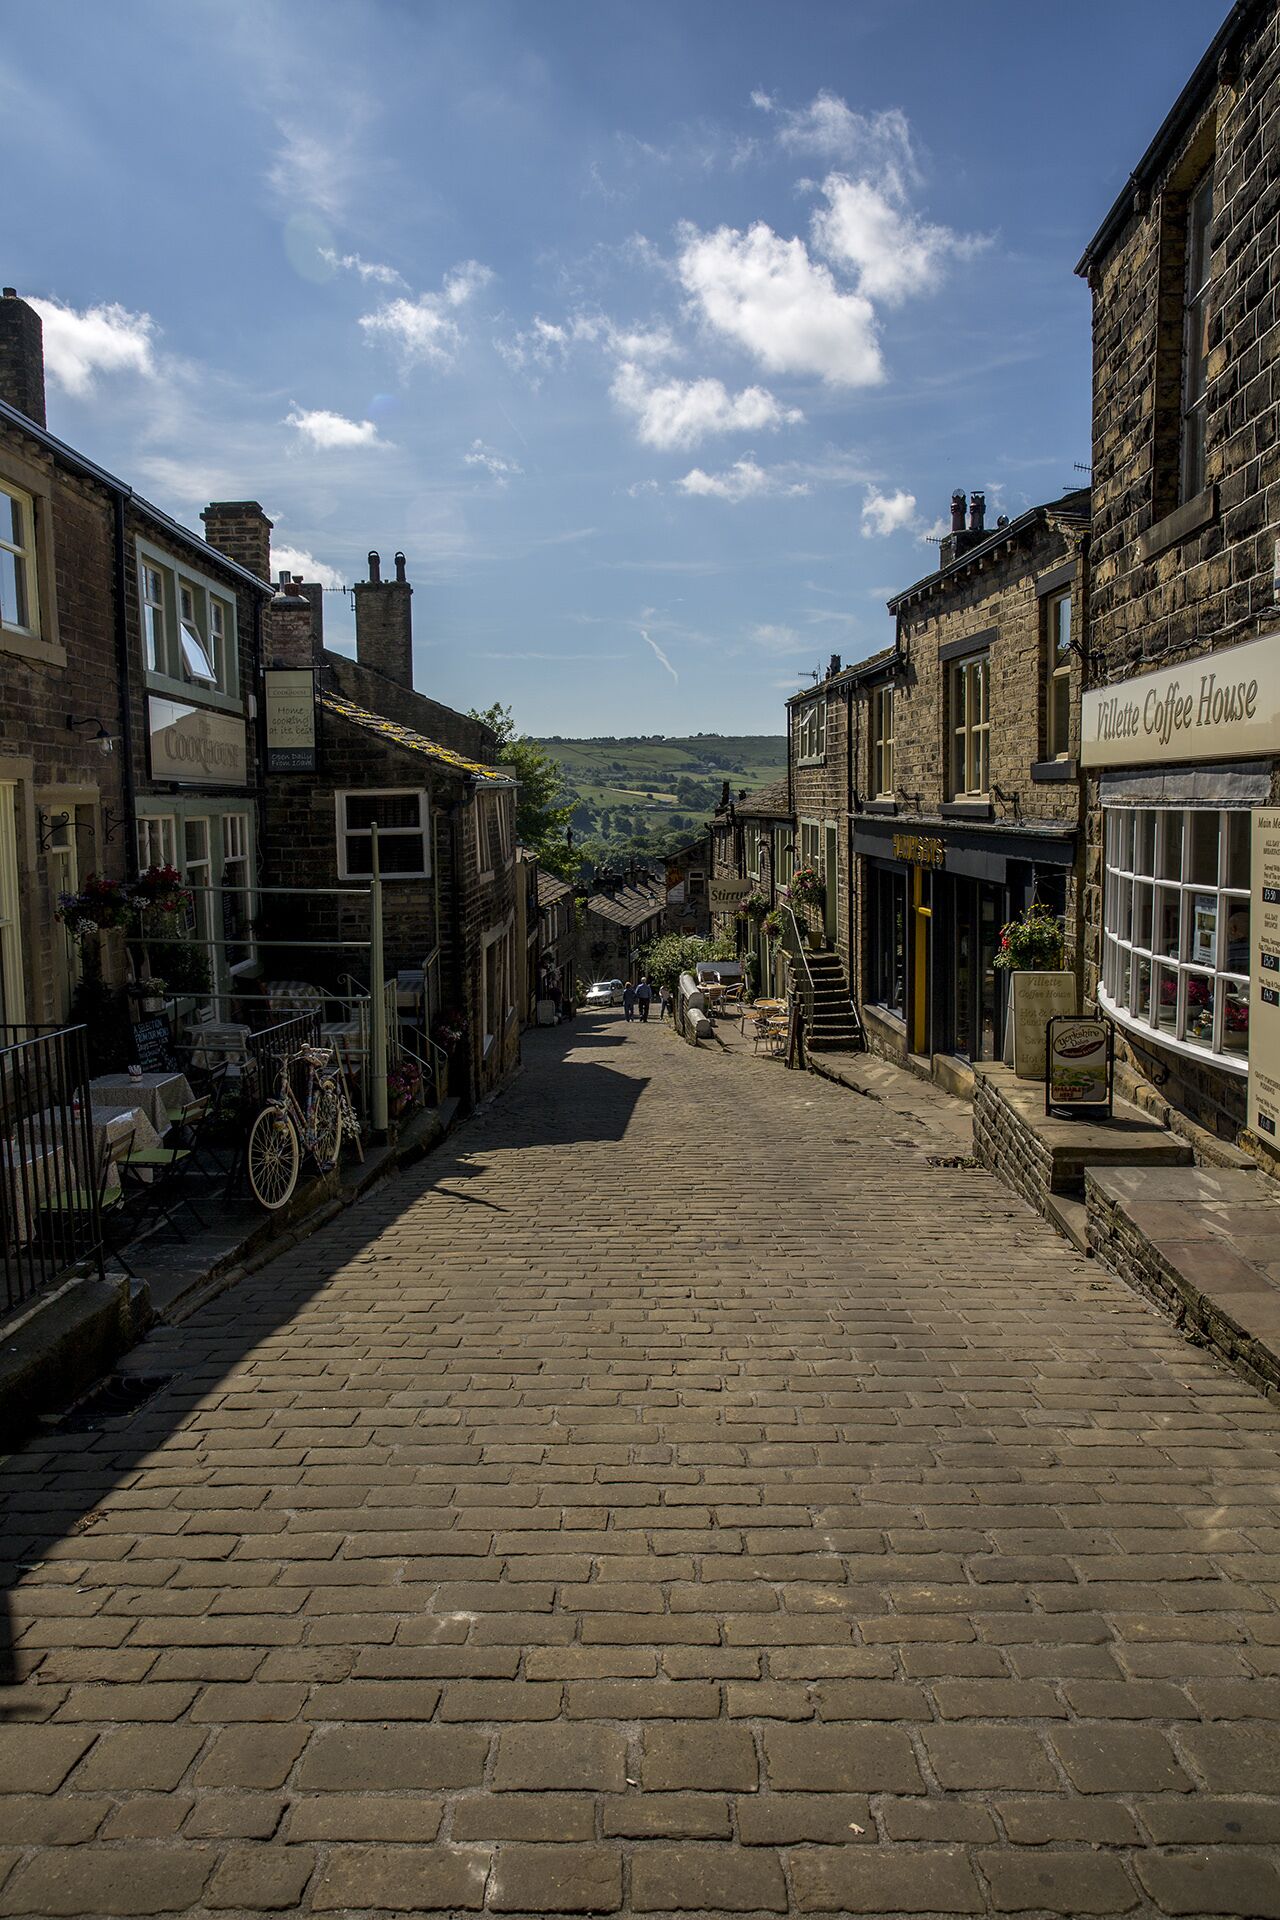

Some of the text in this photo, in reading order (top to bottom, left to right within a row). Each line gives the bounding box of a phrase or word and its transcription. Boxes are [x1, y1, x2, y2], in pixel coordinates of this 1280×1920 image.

[277, 707, 304, 715] Home
[1097, 673, 1259, 745] Villette Coffee House
[272, 715, 310, 728] cooking
[269, 727, 278, 735] at
[295, 726, 313, 735] best
[271, 753, 312, 762] Open Daily
[1258, 816, 1272, 829] Main
[1027, 976, 1063, 987] Villette
[1018, 989, 1072, 1000] Coffee House
[1020, 1008, 1036, 1017] Hot
[1038, 1007, 1048, 1017] &
[1057, 1028, 1100, 1048] Yorkshire
[1022, 1054, 1038, 1064] Hot
